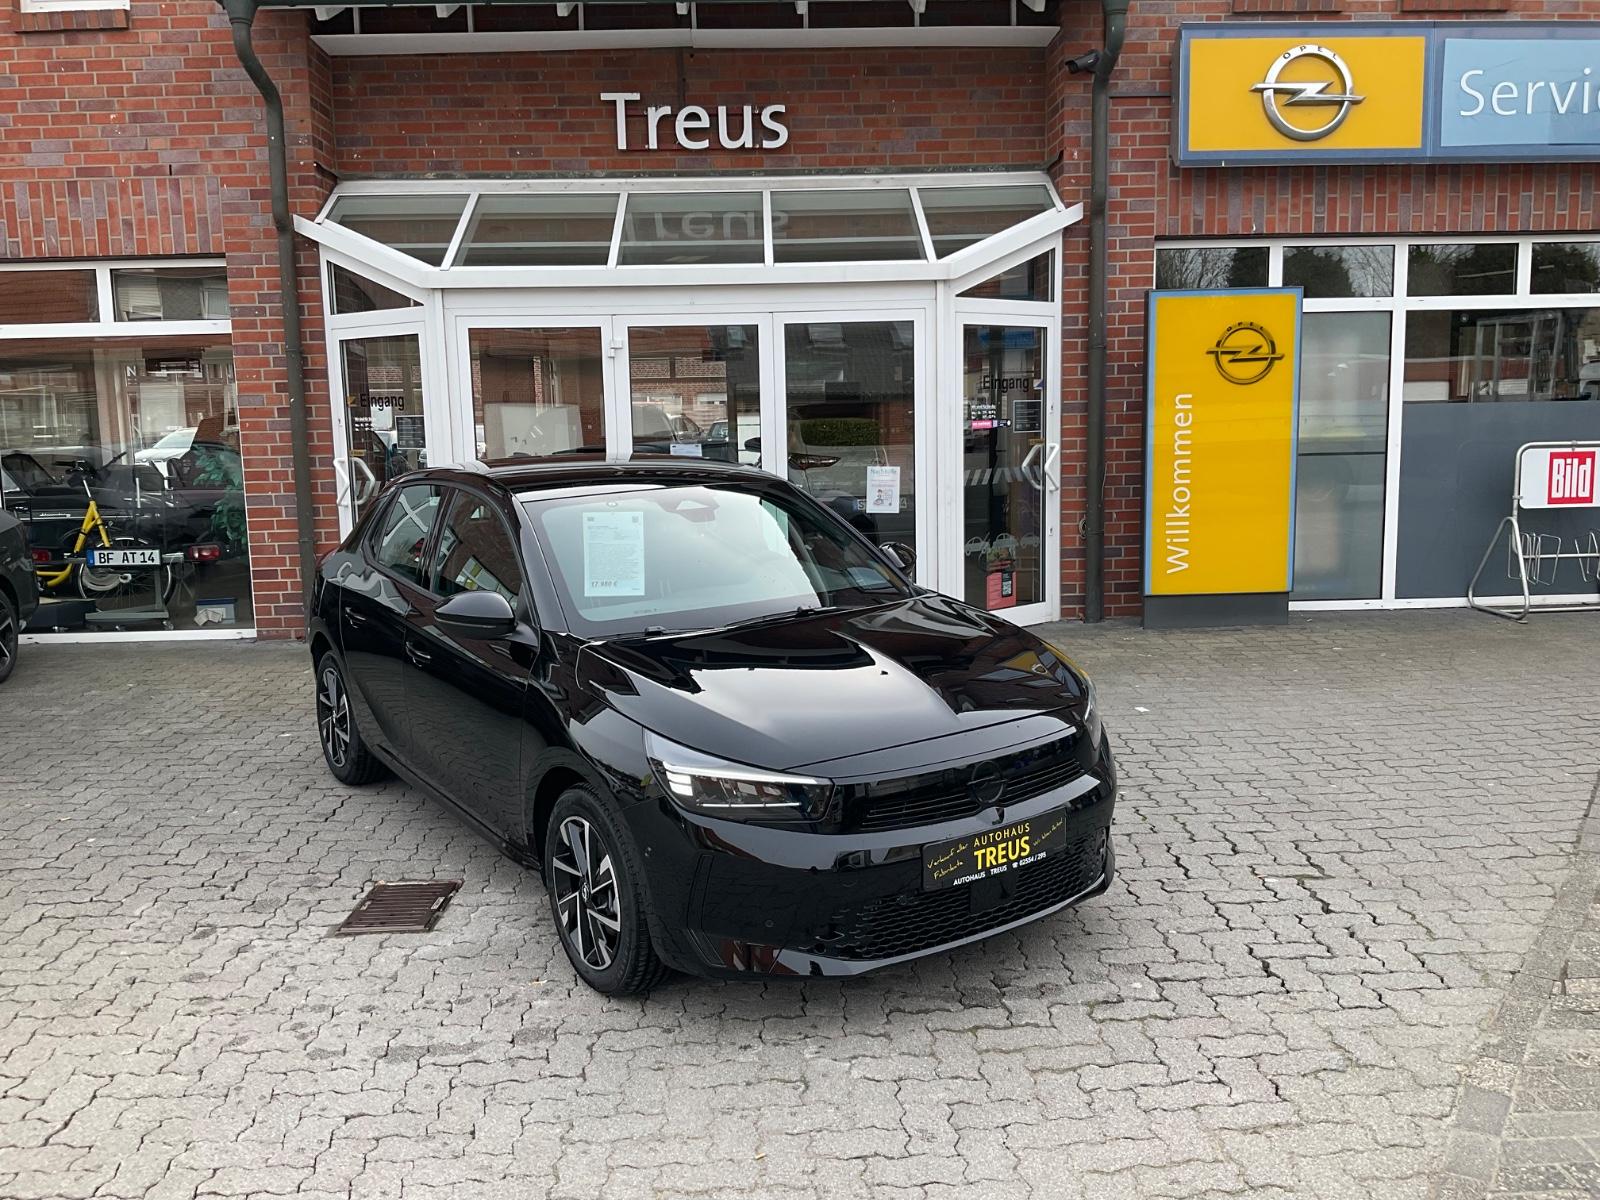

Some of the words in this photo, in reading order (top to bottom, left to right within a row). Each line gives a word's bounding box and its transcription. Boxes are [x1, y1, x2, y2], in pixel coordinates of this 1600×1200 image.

[1283, 44, 1338, 60] OPEL
[1460, 67, 1600, 116] Servi
[600, 92, 789, 150] Treus
[983, 374, 1029, 393] Eingang
[360, 393, 405, 411] Eingang
[1165, 393, 1193, 574] Willkommen
[1551, 457, 1592, 499] Bild
[98, 551, 114, 564] BF
[122, 551, 137, 564] AT
[140, 551, 155, 564] 14
[973, 822, 1031, 848] AUTOHAUS
[974, 836, 1030, 870] TREUS
[953, 870, 986, 886] AUTOHAUS
[990, 863, 1008, 875] TREUS
